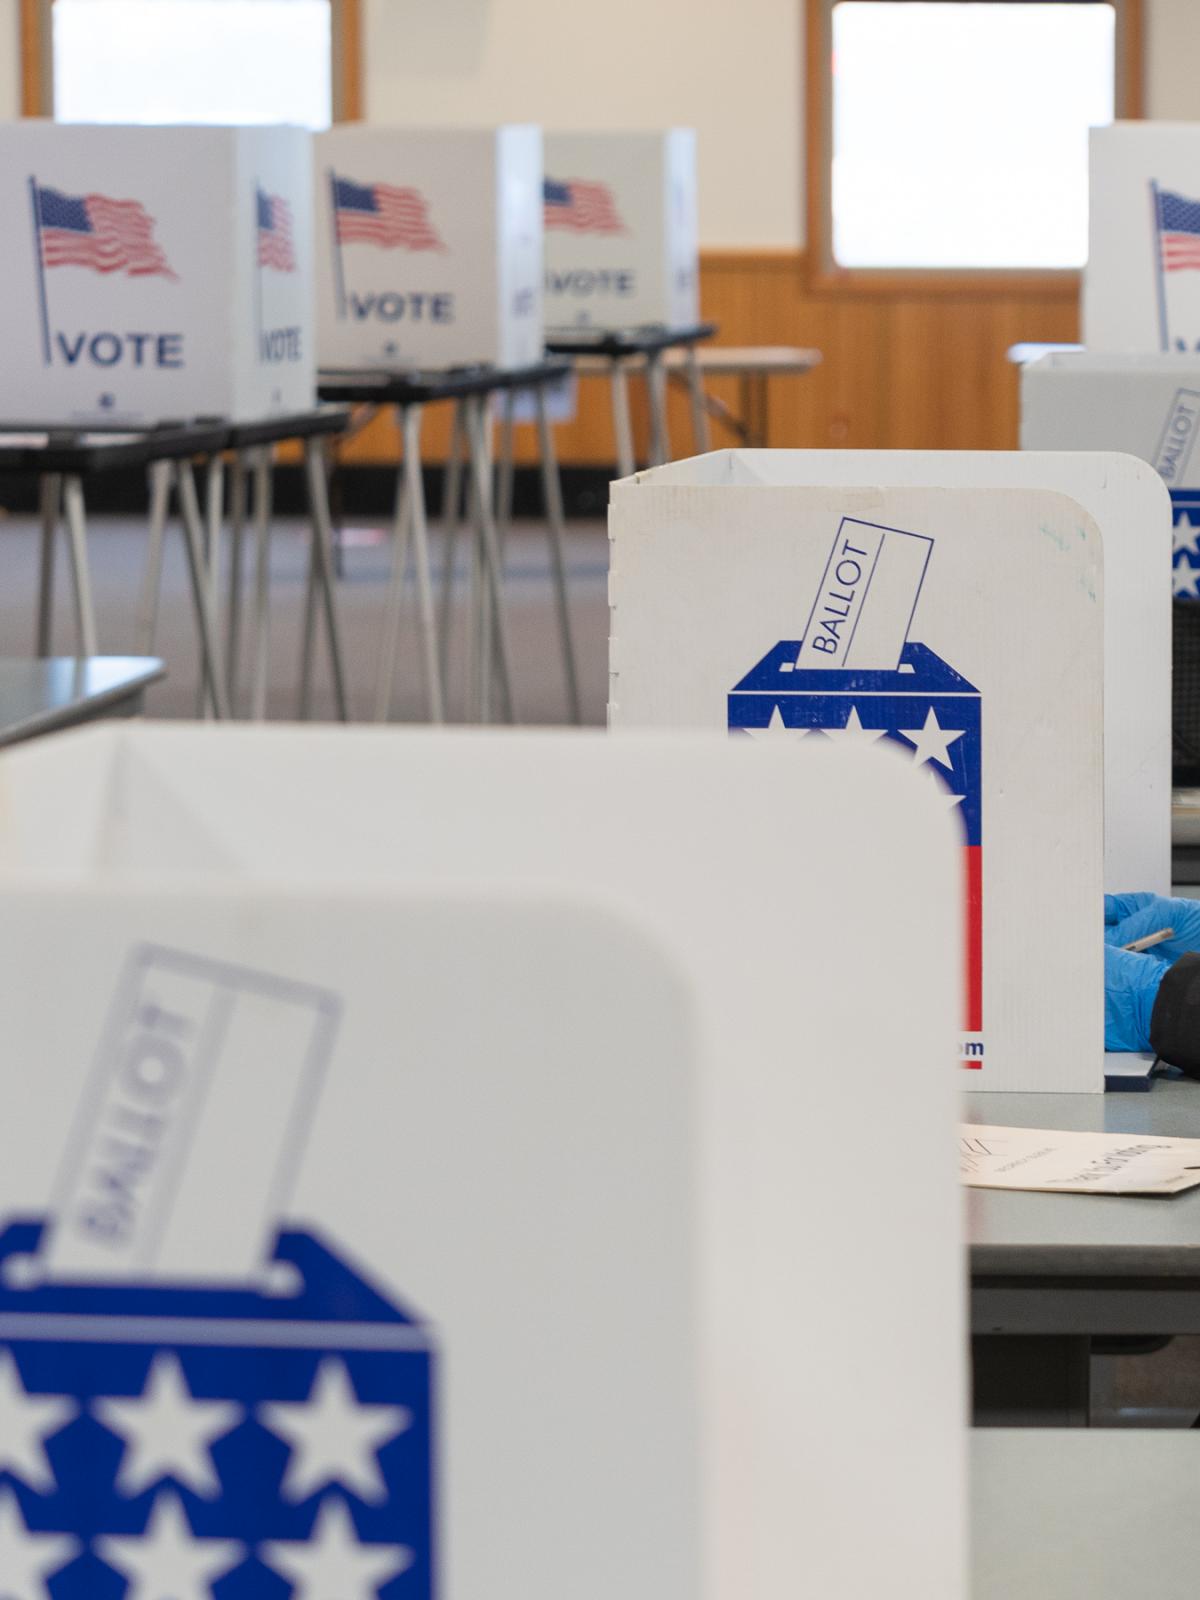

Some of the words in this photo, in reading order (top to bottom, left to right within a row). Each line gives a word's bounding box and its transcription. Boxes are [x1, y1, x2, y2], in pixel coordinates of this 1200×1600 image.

[350, 291, 454, 324] VOTE
[56, 332, 184, 368] VOTE
[1158, 403, 1196, 479] BALLOT
[812, 538, 868, 655] BALLOT
[80, 997, 198, 1250] BALLOT
